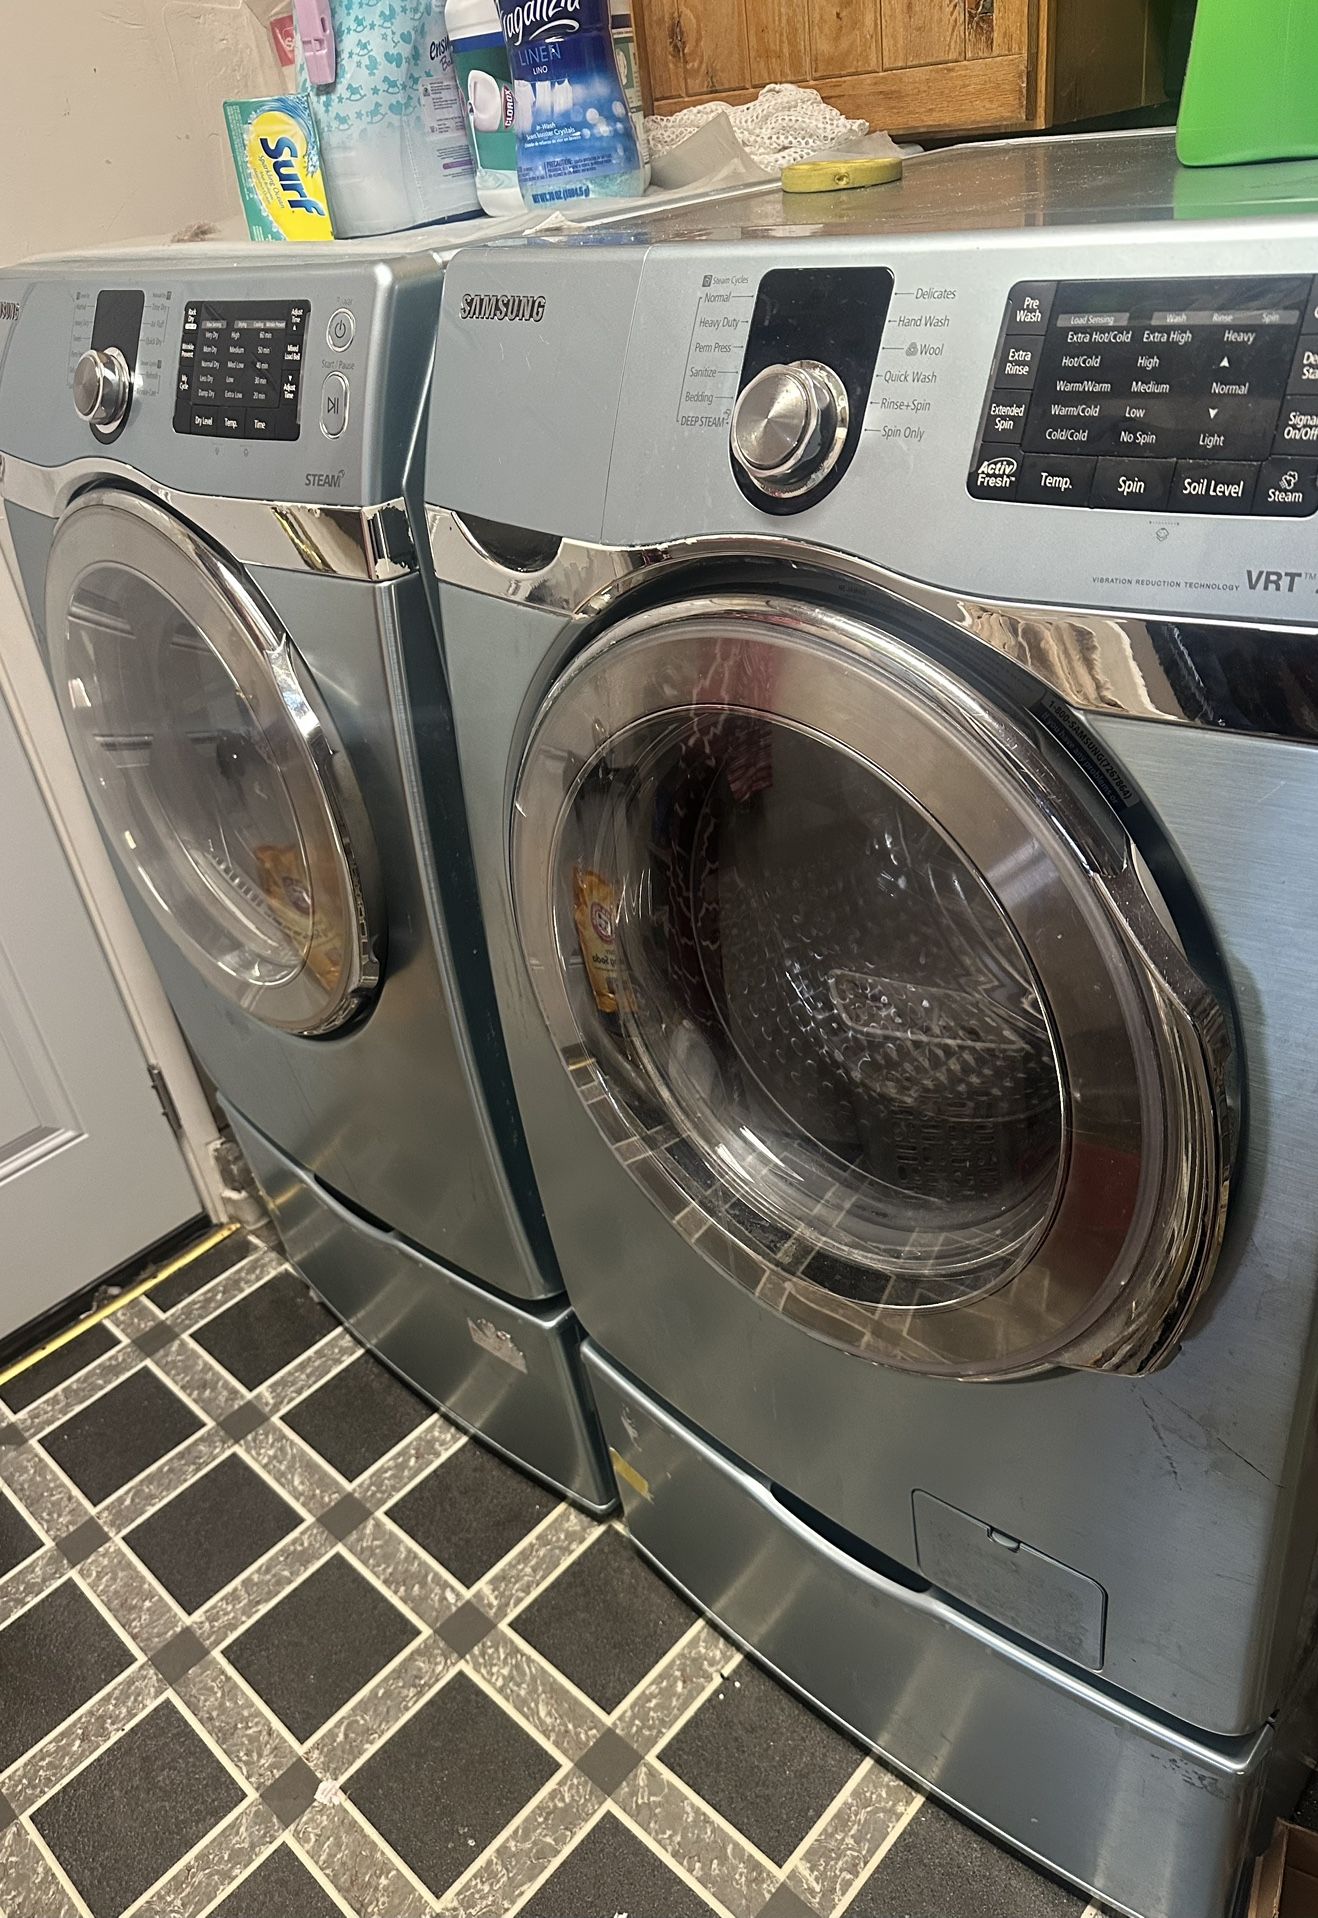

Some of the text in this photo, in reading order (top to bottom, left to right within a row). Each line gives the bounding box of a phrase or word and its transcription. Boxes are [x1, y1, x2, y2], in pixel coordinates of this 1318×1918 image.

[519, 43, 561, 66] LINEN
[533, 66, 548, 76] LINO
[504, 89, 514, 126] CLOROX
[260, 137, 325, 216] Surf
[712, 276, 749, 286] Steam Cycles
[704, 292, 732, 302] Normal
[915, 288, 956, 300] Delicates
[461, 294, 546, 322] SAMSUNG
[1024, 297, 1039, 309] Pre
[291, 308, 303, 317] Adjust
[1016, 310, 1041, 322] Wash
[1166, 313, 1280, 324] Wash Rinse Spin
[700, 317, 740, 330] Heavy Duty
[898, 316, 950, 327] Hand Wash
[1071, 315, 1115, 326] Load Sensing
[1067, 331, 1132, 343] Extra Hot/Cold
[1143, 331, 1192, 345] Extra High
[1224, 330, 1256, 344] Heavy
[695, 343, 732, 352] Perm Press
[920, 344, 944, 356] Wool
[1009, 348, 1031, 361] Extra
[1005, 362, 1029, 375] Rinse
[1062, 356, 1101, 368] Hot/Cold
[1137, 356, 1159, 370] High
[690, 367, 717, 377] Sanitize
[884, 370, 937, 383] Quick Wash
[1302, 367, 1318, 379] Sta
[283, 383, 296, 392] Adjust
[1056, 381, 1111, 392] Warm/Warm
[1131, 381, 1170, 393] Medium
[1211, 382, 1249, 395] Normal
[685, 392, 714, 405] Bedding
[880, 398, 931, 413] Rinse+Spin
[991, 404, 1024, 417] Extended
[1051, 404, 1100, 417] Warm/Cold
[1125, 406, 1145, 418] Low
[202, 417, 213, 425] Level
[225, 418, 238, 429] Temp.
[254, 419, 266, 429] Time
[680, 415, 725, 427] DEEP STEAM
[995, 418, 1014, 431] Spin
[882, 425, 925, 442] Spin Only
[1046, 429, 1089, 441] Cold/Cold
[1120, 431, 1156, 446] No Spin
[1199, 434, 1224, 448] Light
[977, 459, 1014, 474] Activ
[305, 472, 342, 488] STEAM
[1040, 472, 1073, 491] Temp.
[1118, 477, 1145, 495] Spin
[1183, 479, 1244, 497] Soil Level
[1267, 489, 1303, 502] Steam
[1092, 577, 1132, 585] VIBRATION
[1135, 579, 1181, 588] REDUCTION
[1184, 582, 1239, 591] TECHNOLOGY
